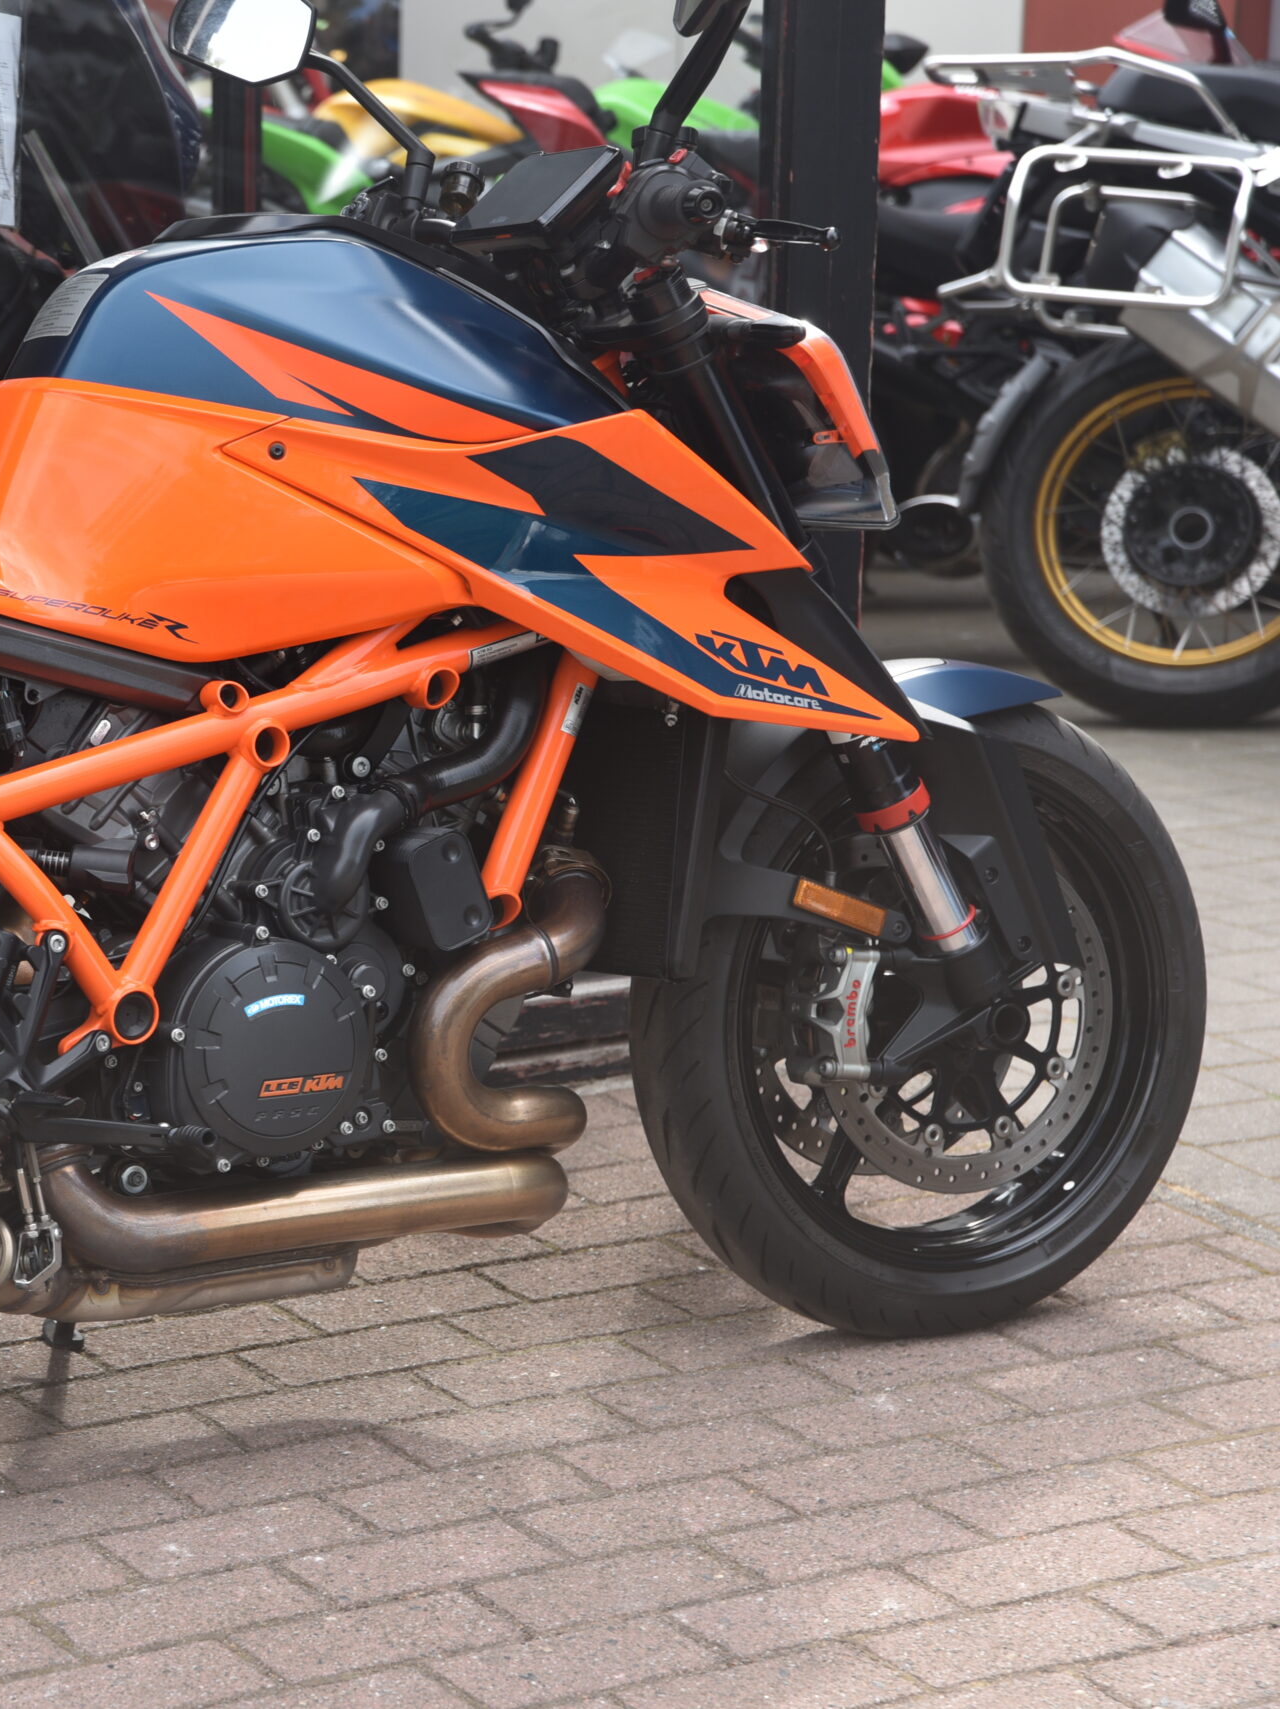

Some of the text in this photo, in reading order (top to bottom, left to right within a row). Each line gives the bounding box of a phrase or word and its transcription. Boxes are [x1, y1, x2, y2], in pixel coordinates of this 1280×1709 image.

[695, 630, 830, 697] KTM
[734, 683, 822, 710] Motocare
[260, 994, 302, 1009] MOTOREX
[844, 980, 861, 1048] brembo
[303, 1073, 344, 1093] KTM
